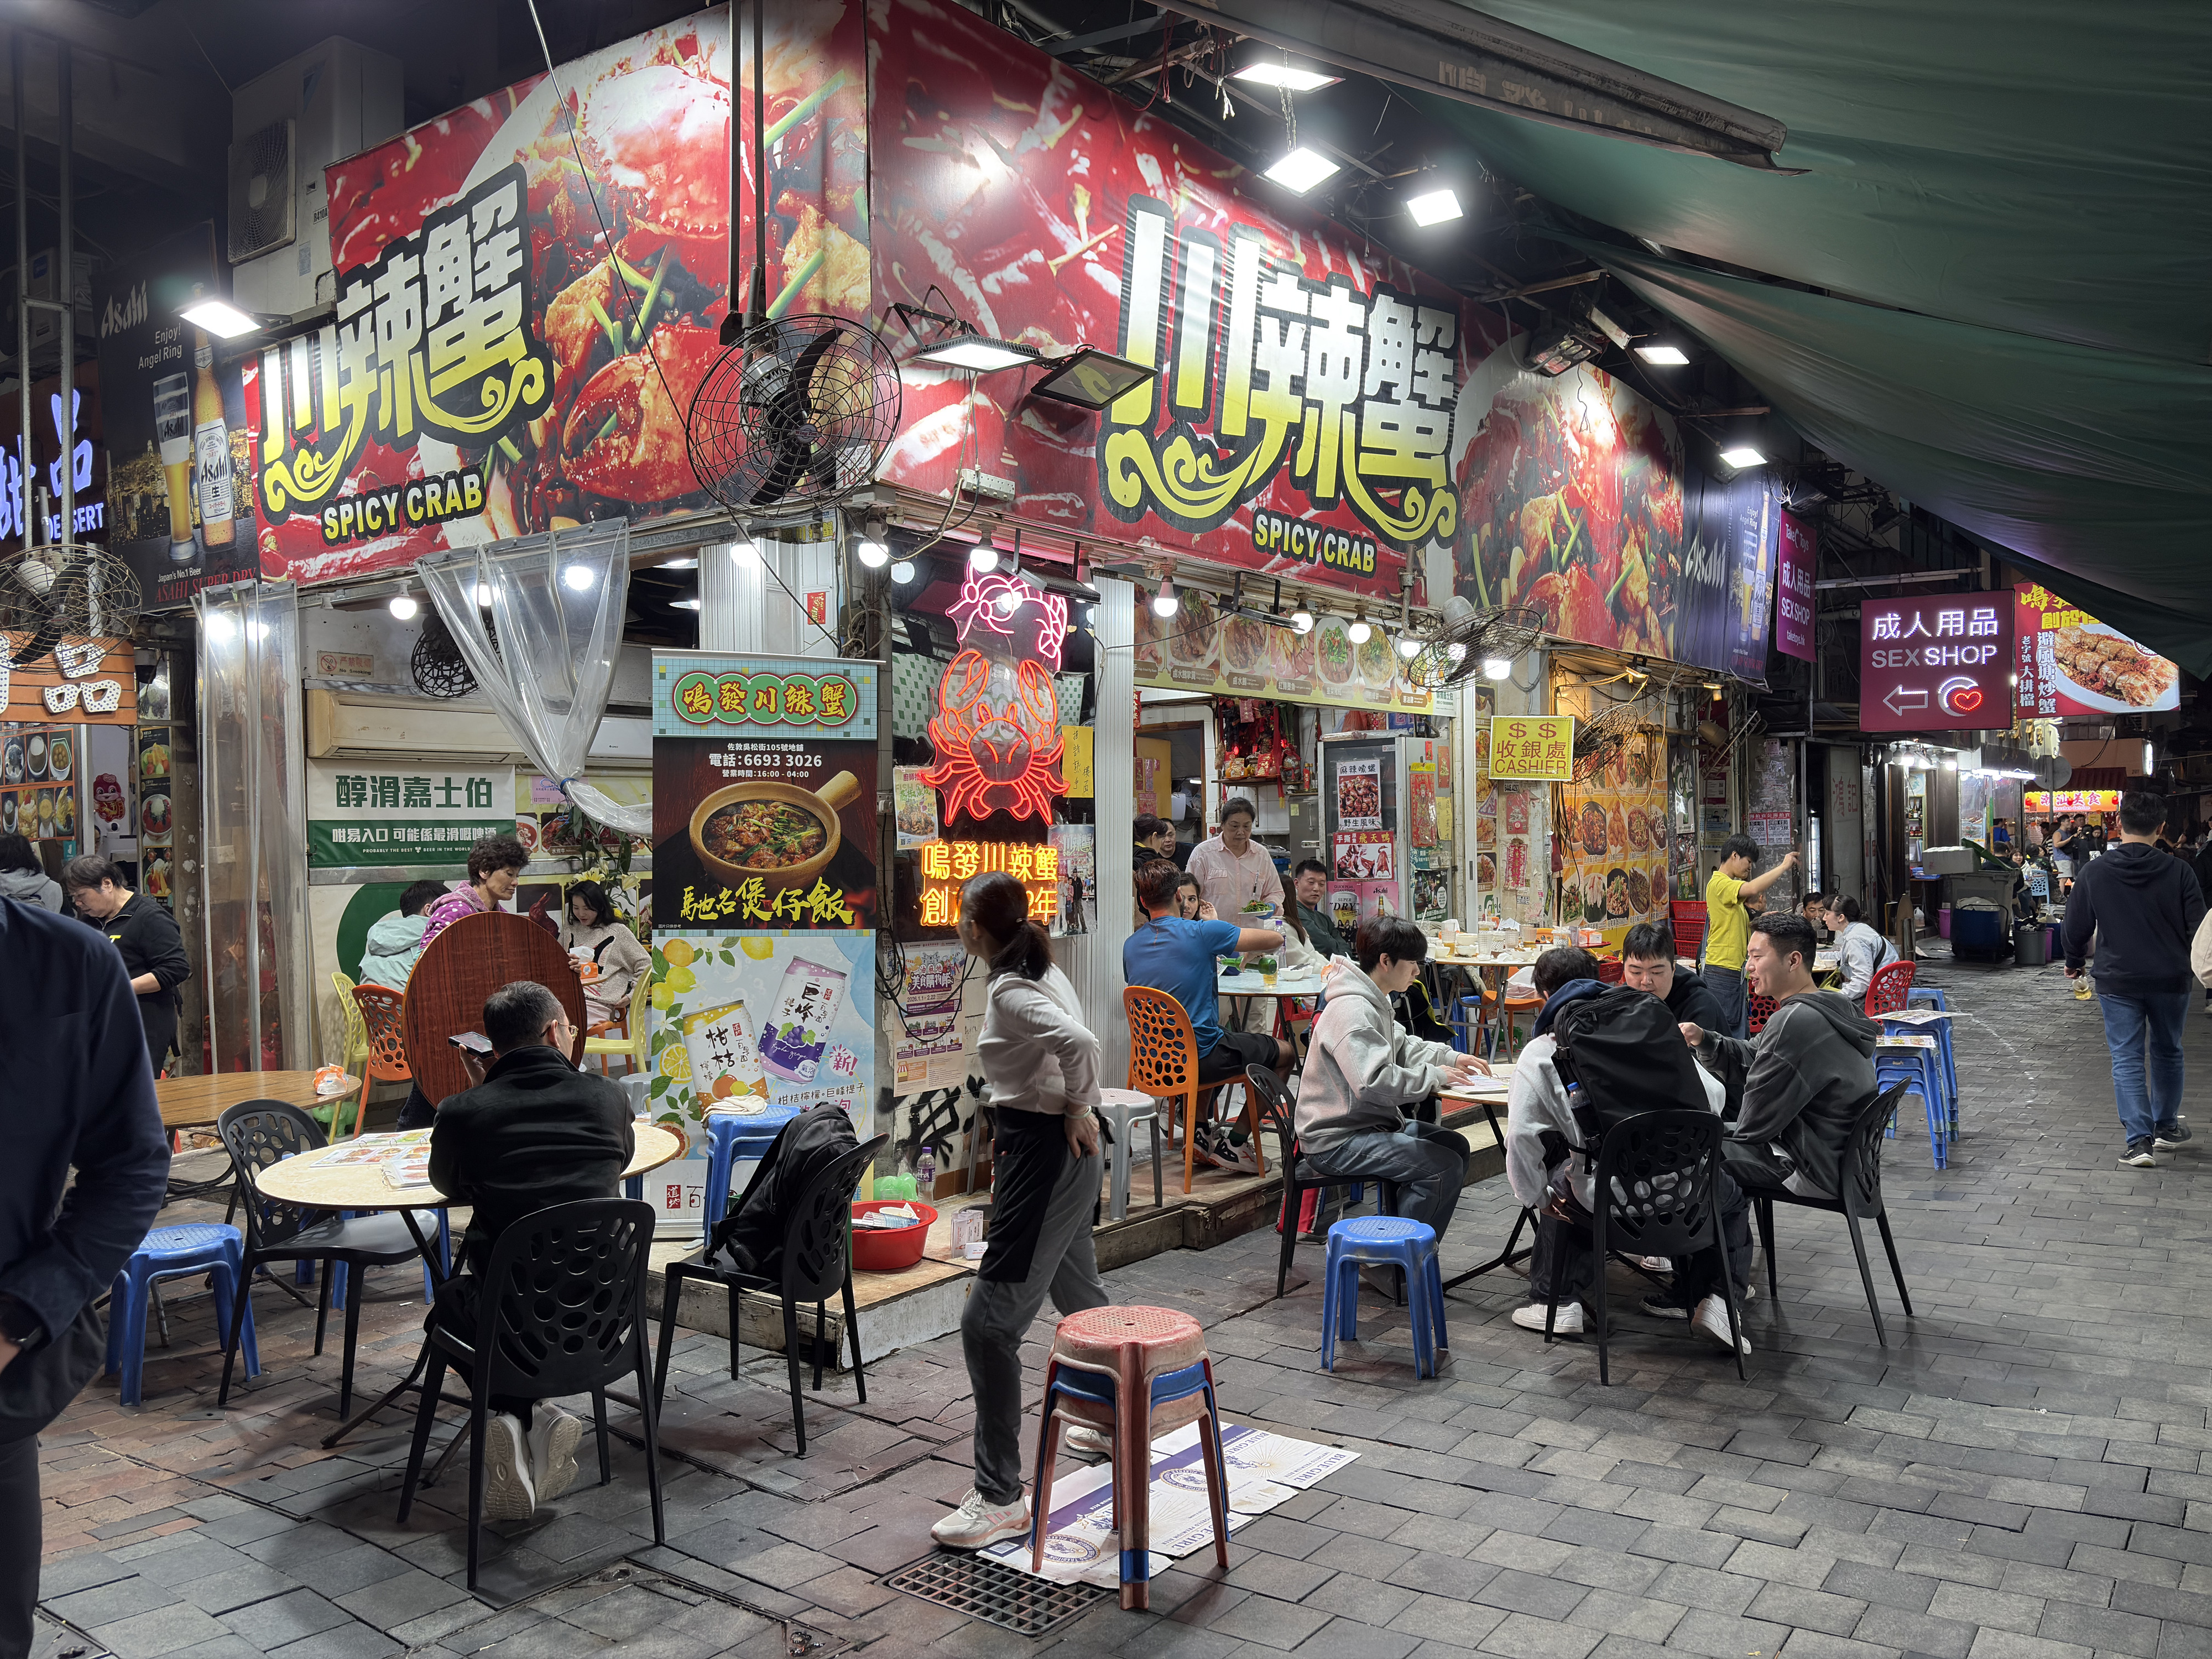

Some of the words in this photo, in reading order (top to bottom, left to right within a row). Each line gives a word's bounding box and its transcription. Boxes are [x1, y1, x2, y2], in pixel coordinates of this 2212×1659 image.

[314, 207, 328, 222] R410A
[101, 279, 148, 338] Asahi
[155, 323, 181, 344] Enjoy!
[263, 179, 545, 512] 川辣蟹
[138, 349, 161, 370] Angel
[163, 344, 182, 359] Ring
[1105, 209, 1457, 541] 川辣蟹
[164, 416, 184, 438] Asahi
[201, 452, 227, 484] Asahi
[212, 485, 220, 498] 生
[325, 494, 398, 540] SPICY
[407, 473, 482, 520] CRAB
[1747, 505, 1758, 517] Enjoy!
[49, 502, 104, 540] DESERT
[1255, 514, 1319, 555] SPICY
[1324, 533, 1375, 572] CRAB
[1786, 523, 1795, 540] Take
[1799, 533, 1809, 552] Toys
[1685, 532, 1726, 591] Asahi
[158, 570, 176, 583] Japan's
[177, 568, 188, 580] No.1
[189, 567, 201, 577] Beer
[1782, 560, 1811, 599] 成人用品
[155, 581, 189, 603] ASAHI
[1781, 597, 1794, 619] SEX
[1794, 603, 1810, 627] SHOP
[1872, 609, 1999, 640] 成人用品
[1787, 629, 1805, 646] taketoys.hk
[1872, 649, 1920, 669] SEX
[1924, 645, 1998, 666] SHOP
[2021, 635, 2032, 663] 老字號
[2036, 631, 2057, 714] 避風塘炒蟹
[2020, 666, 2034, 707] 大排檔
[684, 680, 846, 717] 鳴發川辣蟹
[727, 743, 804, 752] 佐敦吳松街105號地舖
[1496, 740, 1567, 759] 收銀處
[709, 753, 781, 767] 電話:6693
[785, 754, 822, 767] 3026
[1495, 759, 1567, 774] CASHIER
[722, 769, 779, 778] 營業時間:16:00
[336, 775, 492, 808] 醇滑嘉士伯
[1344, 819, 1376, 827] 野生風味
[332, 828, 388, 842] 咁易入口
[1337, 834, 1351, 843] 手撕
[1359, 832, 1390, 843] 飛天鴨
[924, 841, 1058, 882] 鳴發川辣蟹
[681, 876, 855, 924] 馳名煲仔飯
[919, 963, 943, 974] 油麻地
[911, 972, 953, 991] 美食購物節
[706, 1026, 735, 1070] 柑桔
[736, 1039, 749, 1062] 百果園
[801, 1064, 816, 1074] 氣泡
[668, 1186, 680, 1208] 道地
[1244, 1433, 1269, 1445] BLUE
[1293, 1462, 1312, 1473] PREMIUM
[1311, 1452, 1330, 1463] IMPORTED
[1317, 1453, 1346, 1470] BLUE
[1173, 1526, 1194, 1538] PREMIUM
[1194, 1516, 1212, 1526] PORTED
[1089, 1558, 1107, 1569] PREMIUM
